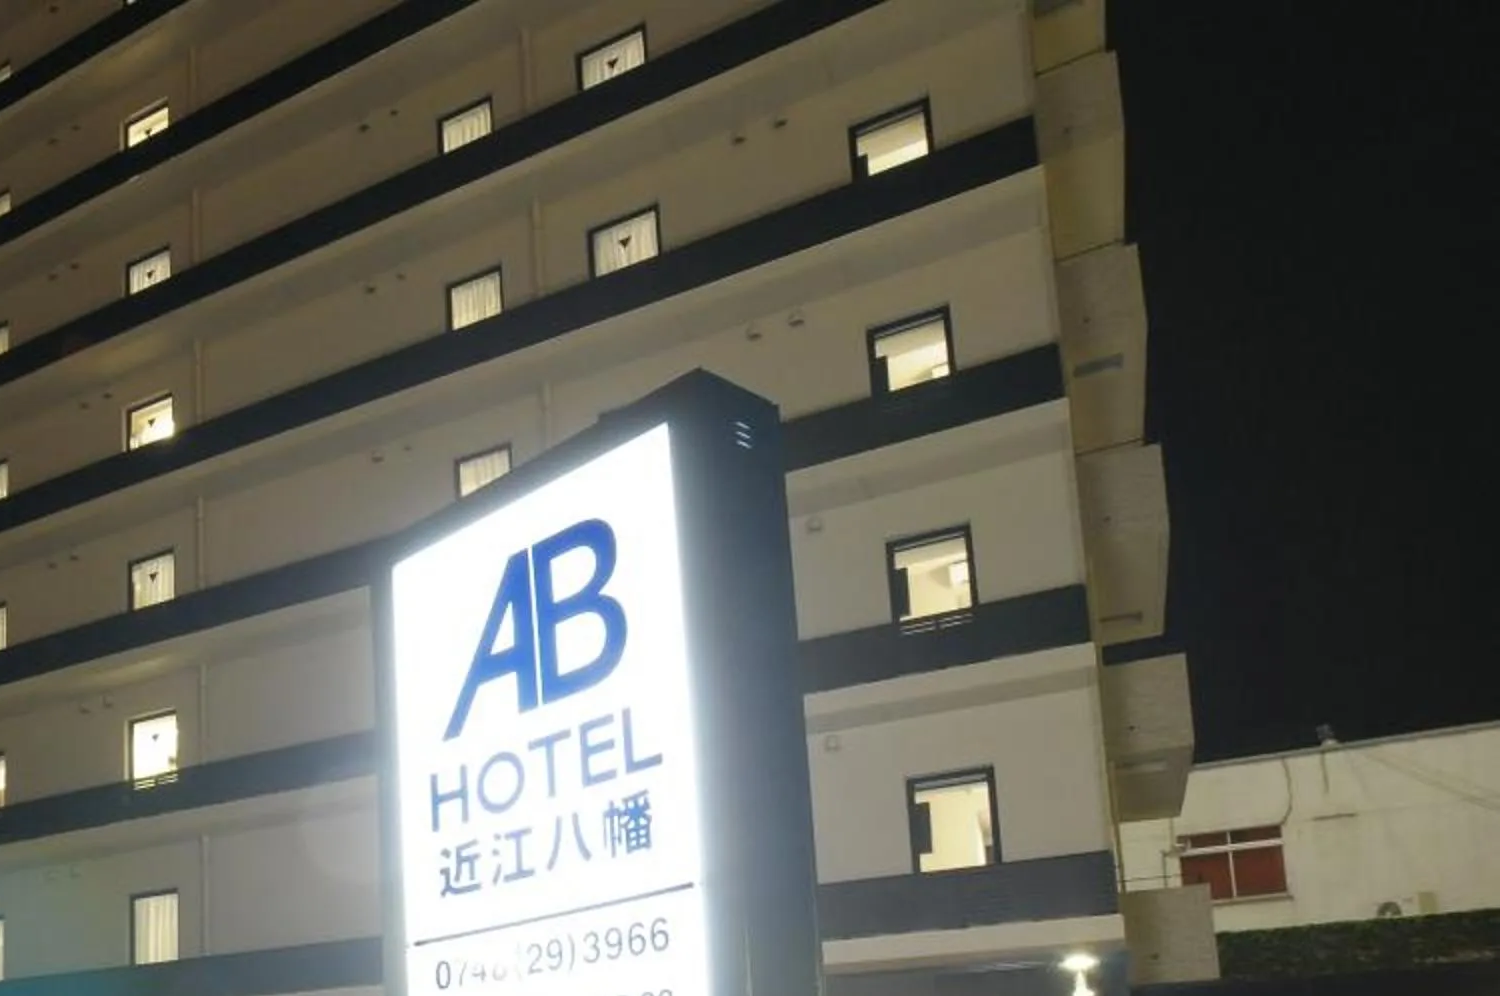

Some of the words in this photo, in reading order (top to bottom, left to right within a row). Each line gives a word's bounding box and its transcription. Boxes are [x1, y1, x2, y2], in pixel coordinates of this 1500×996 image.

[442, 517, 628, 742] AB
[430, 708, 662, 832] HOTEL
[440, 789, 652, 897] 近江八幡
